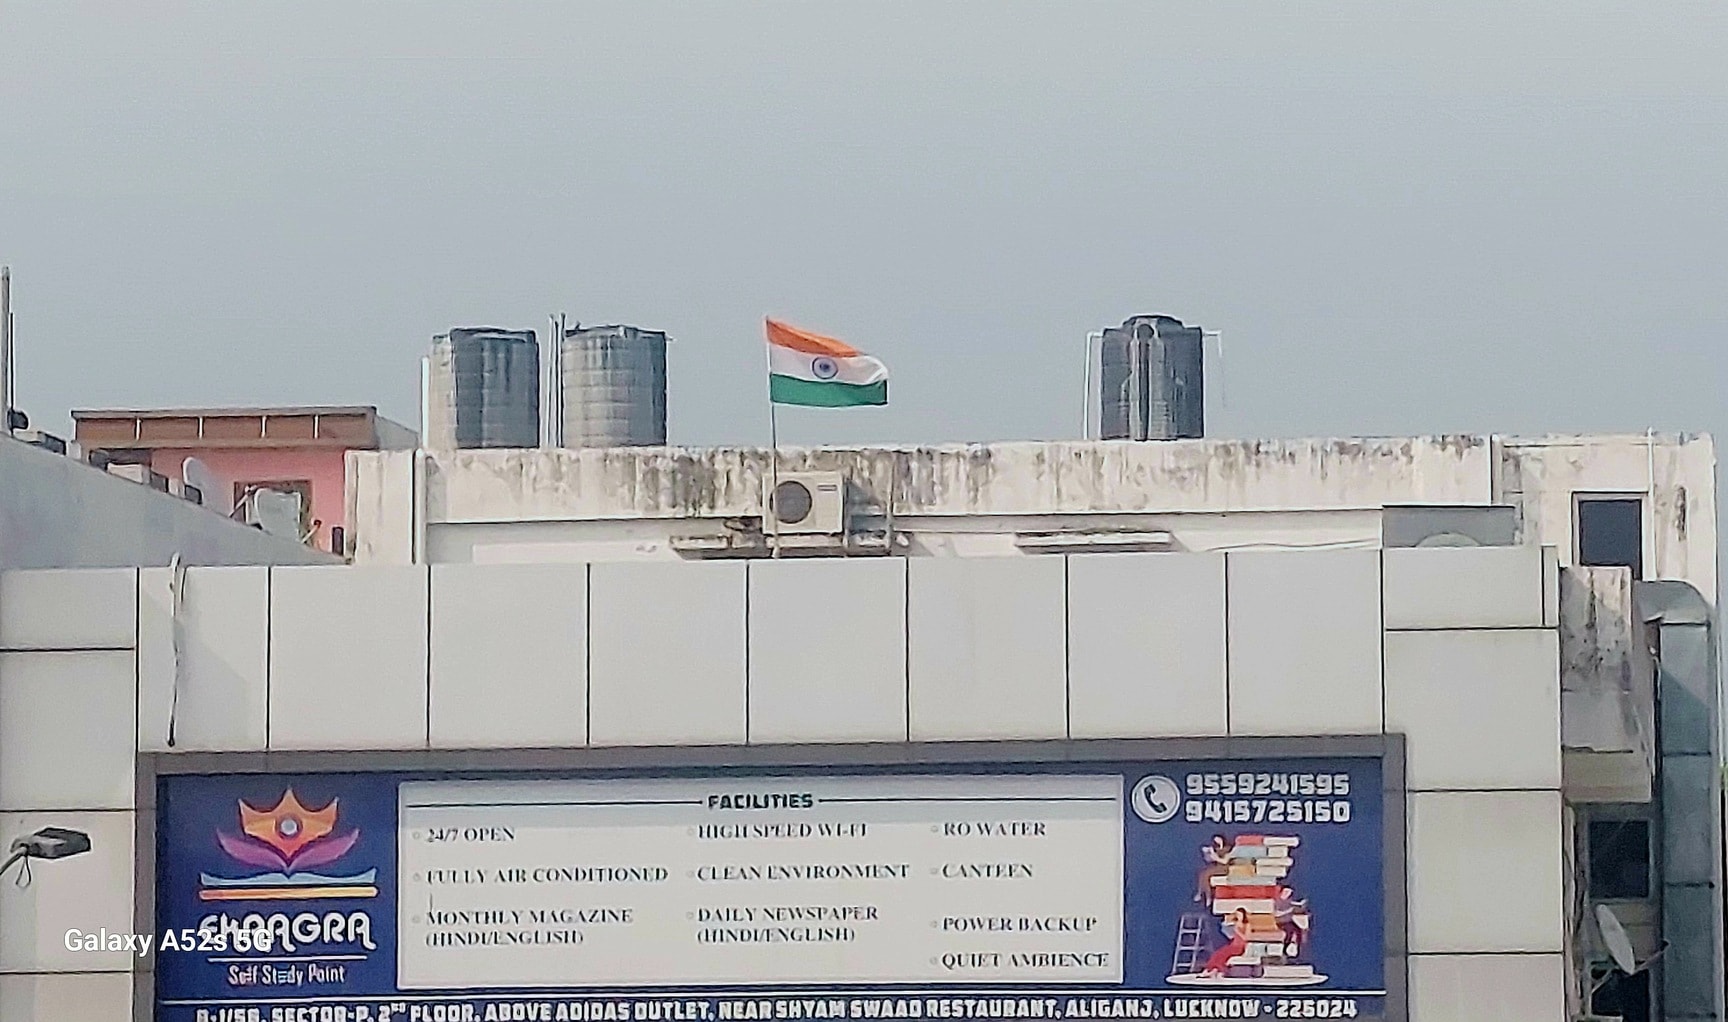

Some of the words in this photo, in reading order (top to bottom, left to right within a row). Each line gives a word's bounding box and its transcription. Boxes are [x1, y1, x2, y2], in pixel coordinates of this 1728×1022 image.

[1186, 773, 1350, 795] 9559241595
[707, 794, 814, 809] FACILITIES
[1185, 800, 1351, 823] 9415725150
[427, 828, 459, 843] 24/7
[463, 827, 515, 842] OPEN
[698, 823, 748, 839] HIGH
[752, 823, 812, 838] SPEED
[818, 822, 867, 838] WI-FI
[943, 822, 971, 836] RO
[976, 822, 1046, 836] WATER
[426, 869, 486, 884] FULLY
[494, 869, 527, 883] AIR
[532, 867, 669, 883] CONDITIONED
[697, 865, 762, 881] CLEAN
[767, 864, 910, 880] ENVIRONMENT
[942, 863, 1033, 878] CANTEEN
[426, 909, 523, 925] MONTHLY
[529, 908, 634, 924] MAGAZINE
[697, 907, 757, 922] DAILY
[762, 906, 879, 921] NEWSPAPER
[943, 917, 1013, 932] POWER
[1019, 916, 1097, 931] BACKUP
[425, 930, 584, 947] (HINDI/ENGLISH)
[696, 927, 856, 943] (HINDI/ENGLISH)
[942, 953, 1002, 970] QUIET
[1009, 952, 1110, 967] AMBIENCE
[308, 963, 346, 983] Point
[484, 1002, 552, 1022] ABOVE
[555, 1002, 630, 1021] ADIDAS
[634, 1002, 715, 1021] OUTLET,
[719, 1001, 772, 1020] NEAR
[776, 1001, 845, 1020] SHYAM
[851, 1000, 922, 1018] SWAAD
[927, 1000, 1062, 1018] RESTAURANT,
[1065, 999, 1160, 1018] ALIGANJ,
[1164, 999, 1261, 1017] LUCKNOW
[1276, 998, 1358, 1017] 225024
